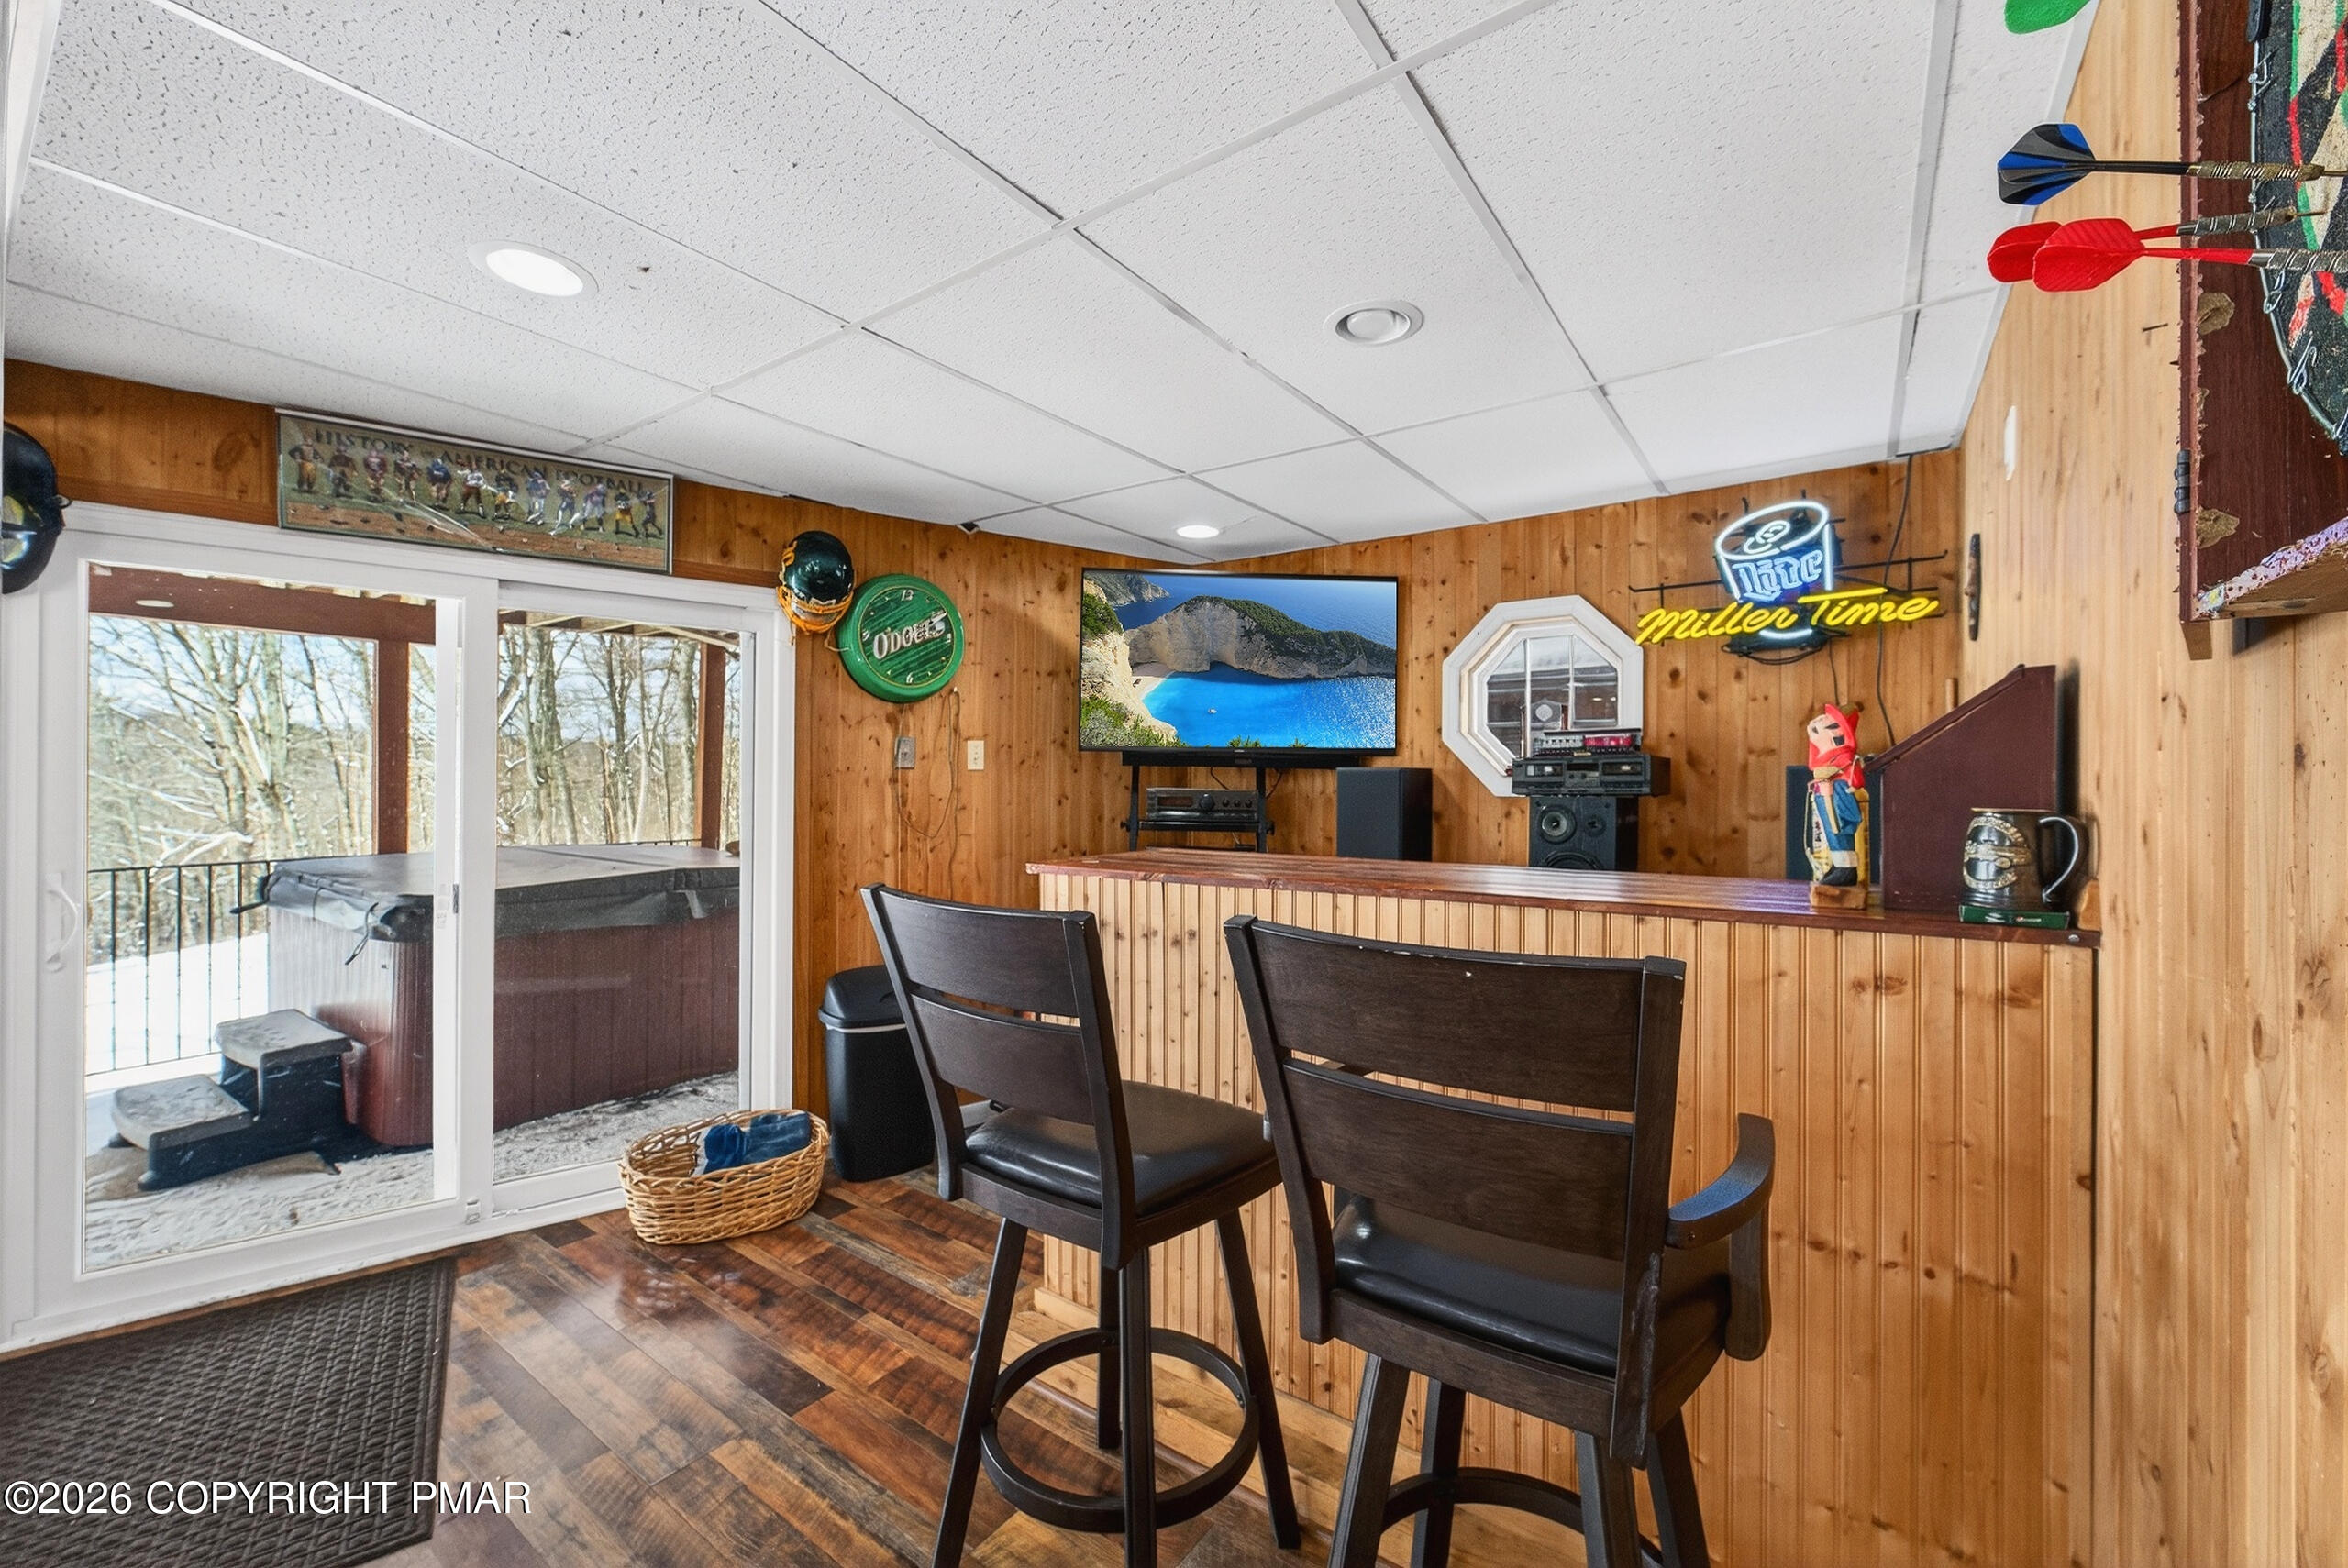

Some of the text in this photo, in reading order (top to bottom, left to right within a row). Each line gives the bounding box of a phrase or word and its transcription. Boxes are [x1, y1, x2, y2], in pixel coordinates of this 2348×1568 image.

[316, 428, 414, 453] HISTORY
[440, 450, 547, 480] AMERICAN
[1634, 587, 1940, 646] Miller Time
